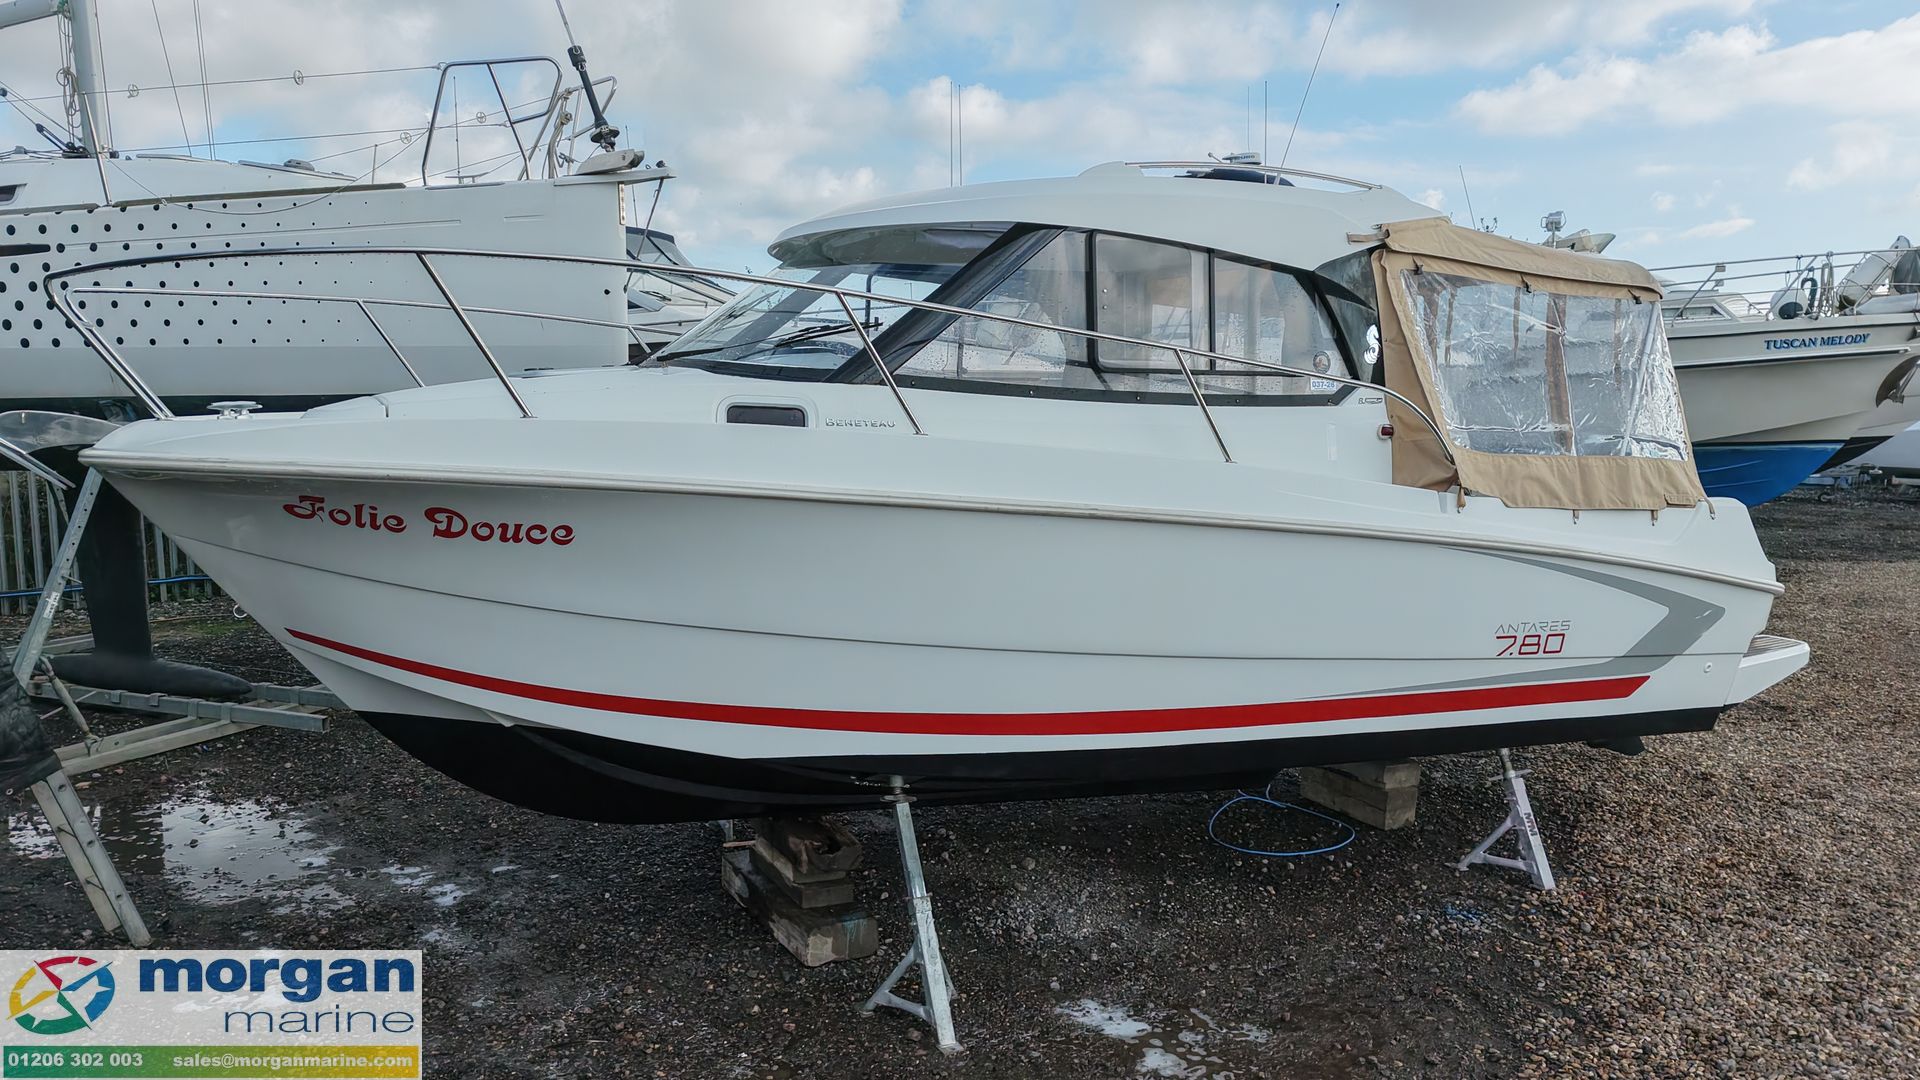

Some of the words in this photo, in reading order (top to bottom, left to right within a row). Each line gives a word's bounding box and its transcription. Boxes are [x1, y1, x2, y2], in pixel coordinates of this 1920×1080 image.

[1764, 337, 1816, 350] TUSCAN
[1820, 333, 1871, 346] MELODY
[826, 417, 896, 427] BENETEAU
[283, 495, 407, 533] Folie
[424, 507, 575, 545] Douce
[1495, 620, 1571, 633] ANTARES
[1496, 633, 1565, 656] 7.80
